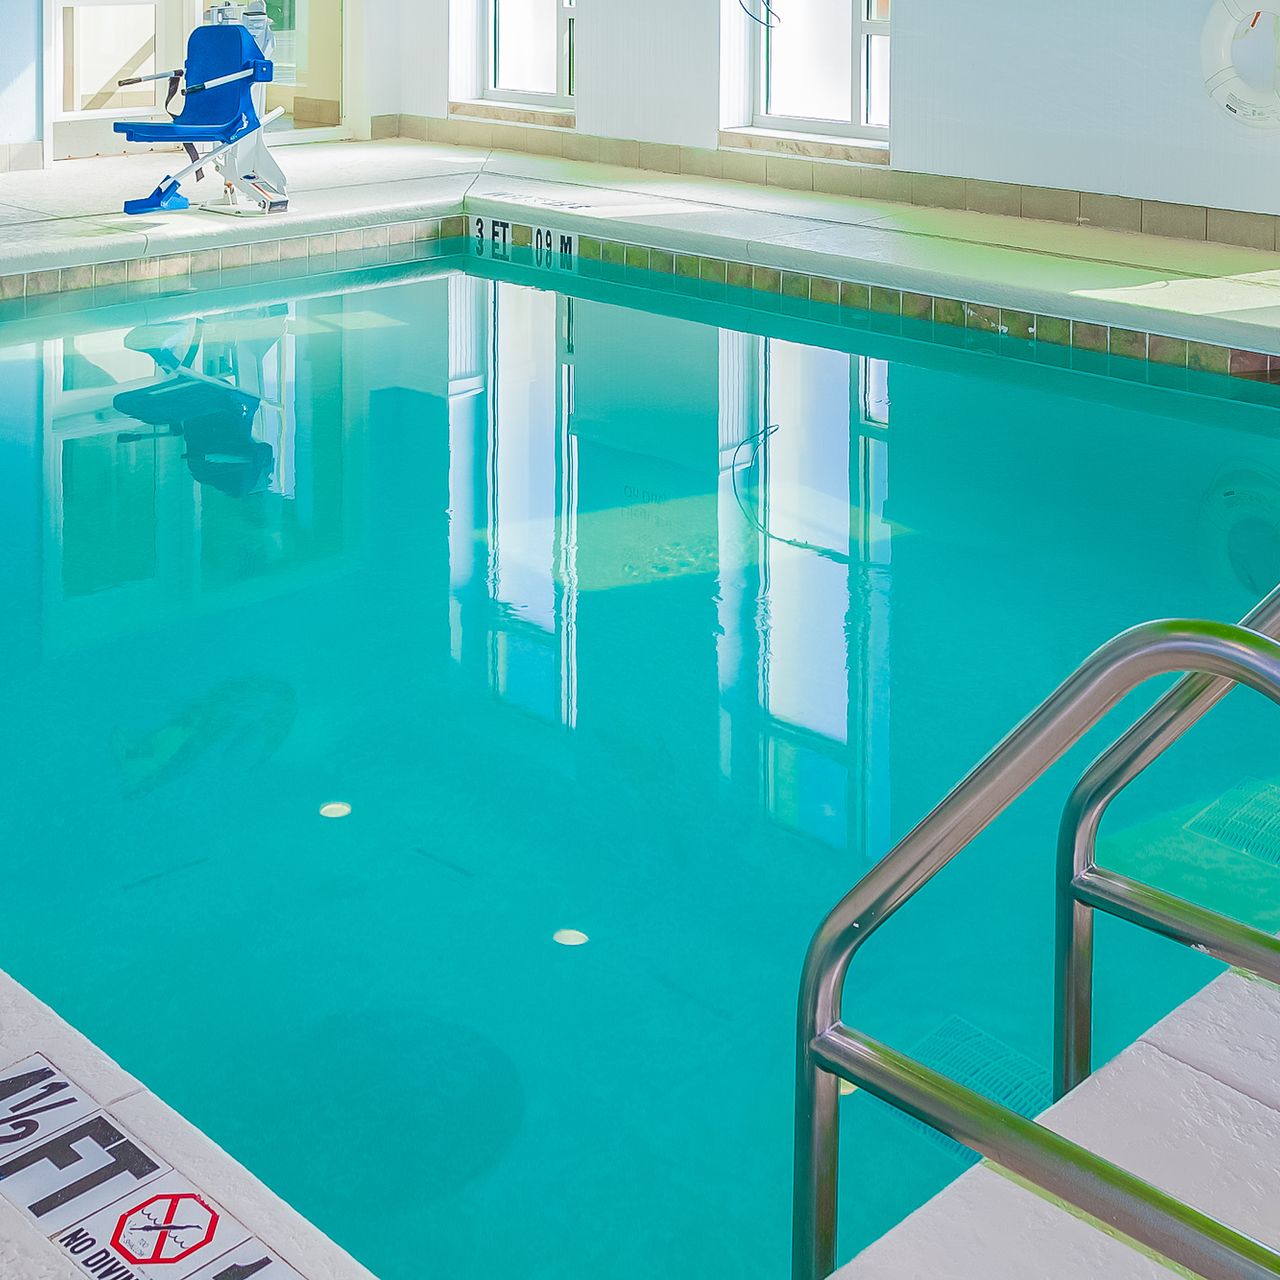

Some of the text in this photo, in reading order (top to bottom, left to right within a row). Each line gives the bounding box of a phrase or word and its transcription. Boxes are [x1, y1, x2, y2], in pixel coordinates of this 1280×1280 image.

[491, 219, 510, 244] FT
[559, 234, 573, 255] M
[58, 1227, 97, 1256] NO
